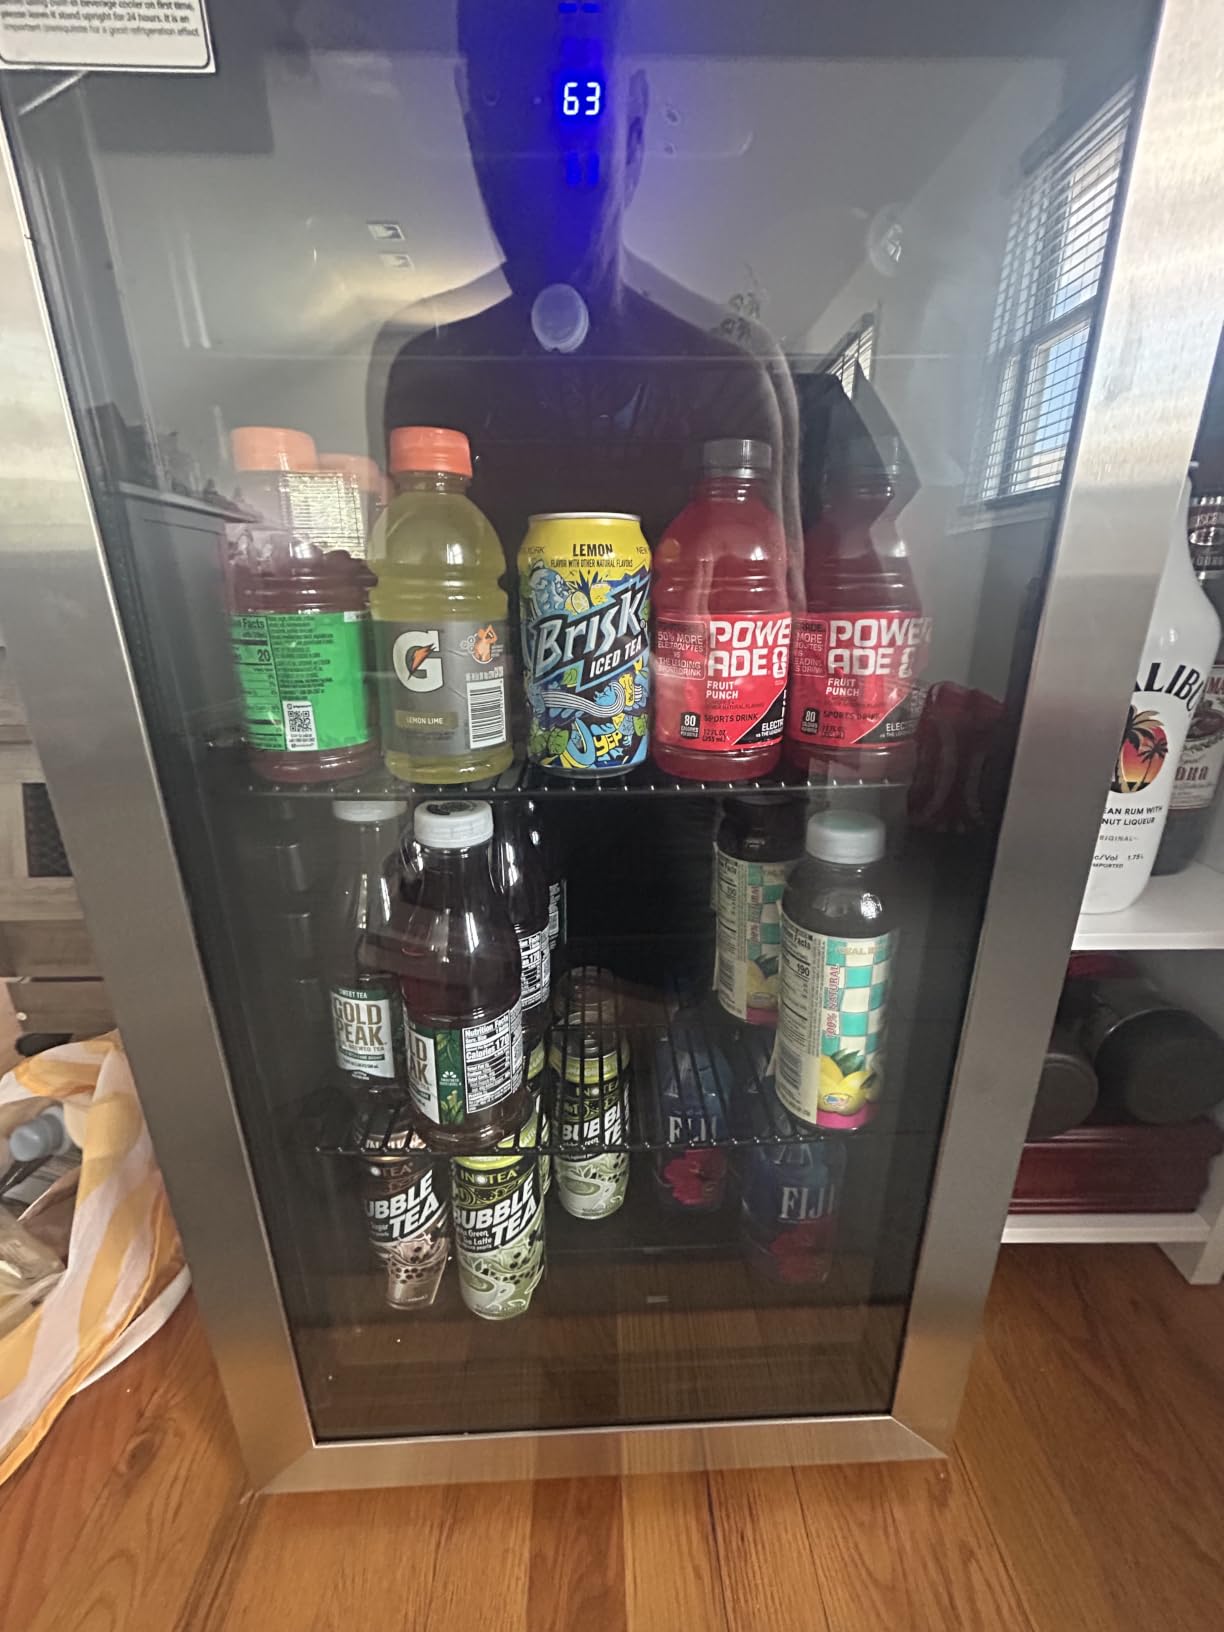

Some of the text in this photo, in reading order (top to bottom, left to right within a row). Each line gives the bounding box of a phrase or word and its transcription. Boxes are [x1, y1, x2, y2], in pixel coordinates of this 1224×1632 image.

[82, 11, 112, 23] upright
[562, 81, 601, 116] 63
[572, 543, 614, 557] LEMON
[550, 559, 633, 568] FLAVOR WITH OTHER NATURAL FLAVORS
[677, 633, 704, 645] MORE
[257, 649, 271, 662] 20
[392, 630, 444, 693] G
[589, 634, 642, 678] ICED TEA
[706, 680, 735, 690] FRUIT
[828, 677, 856, 687] FRUIT
[705, 690, 739, 700] PUNCH
[825, 687, 860, 697] PUNCH
[406, 717, 444, 725] LEMON LIME
[684, 714, 697, 727] 80
[704, 713, 759, 723] SPORTS DRINK
[805, 710, 816, 723] 80
[1124, 807, 1144, 815] RUM
[1146, 806, 1163, 814] WITH
[1101, 817, 1156, 826] NUT LIQUEUR
[797, 962, 810, 977] 190
[829, 964, 841, 1010] NATURAL
[356, 991, 368, 999] TEA
[333, 996, 383, 1026] GOLD
[335, 1017, 385, 1047] PEAK
[465, 1014, 509, 1038] Nutrition Facts
[466, 1033, 510, 1060] Calories 170
[453, 1172, 534, 1230] BUBBLE
[780, 1184, 835, 1219] FIJI
[389, 1191, 440, 1239] TEA
[491, 1195, 537, 1247] TEA
[468, 1230, 489, 1238] Green
[473, 1237, 493, 1245] Latte
